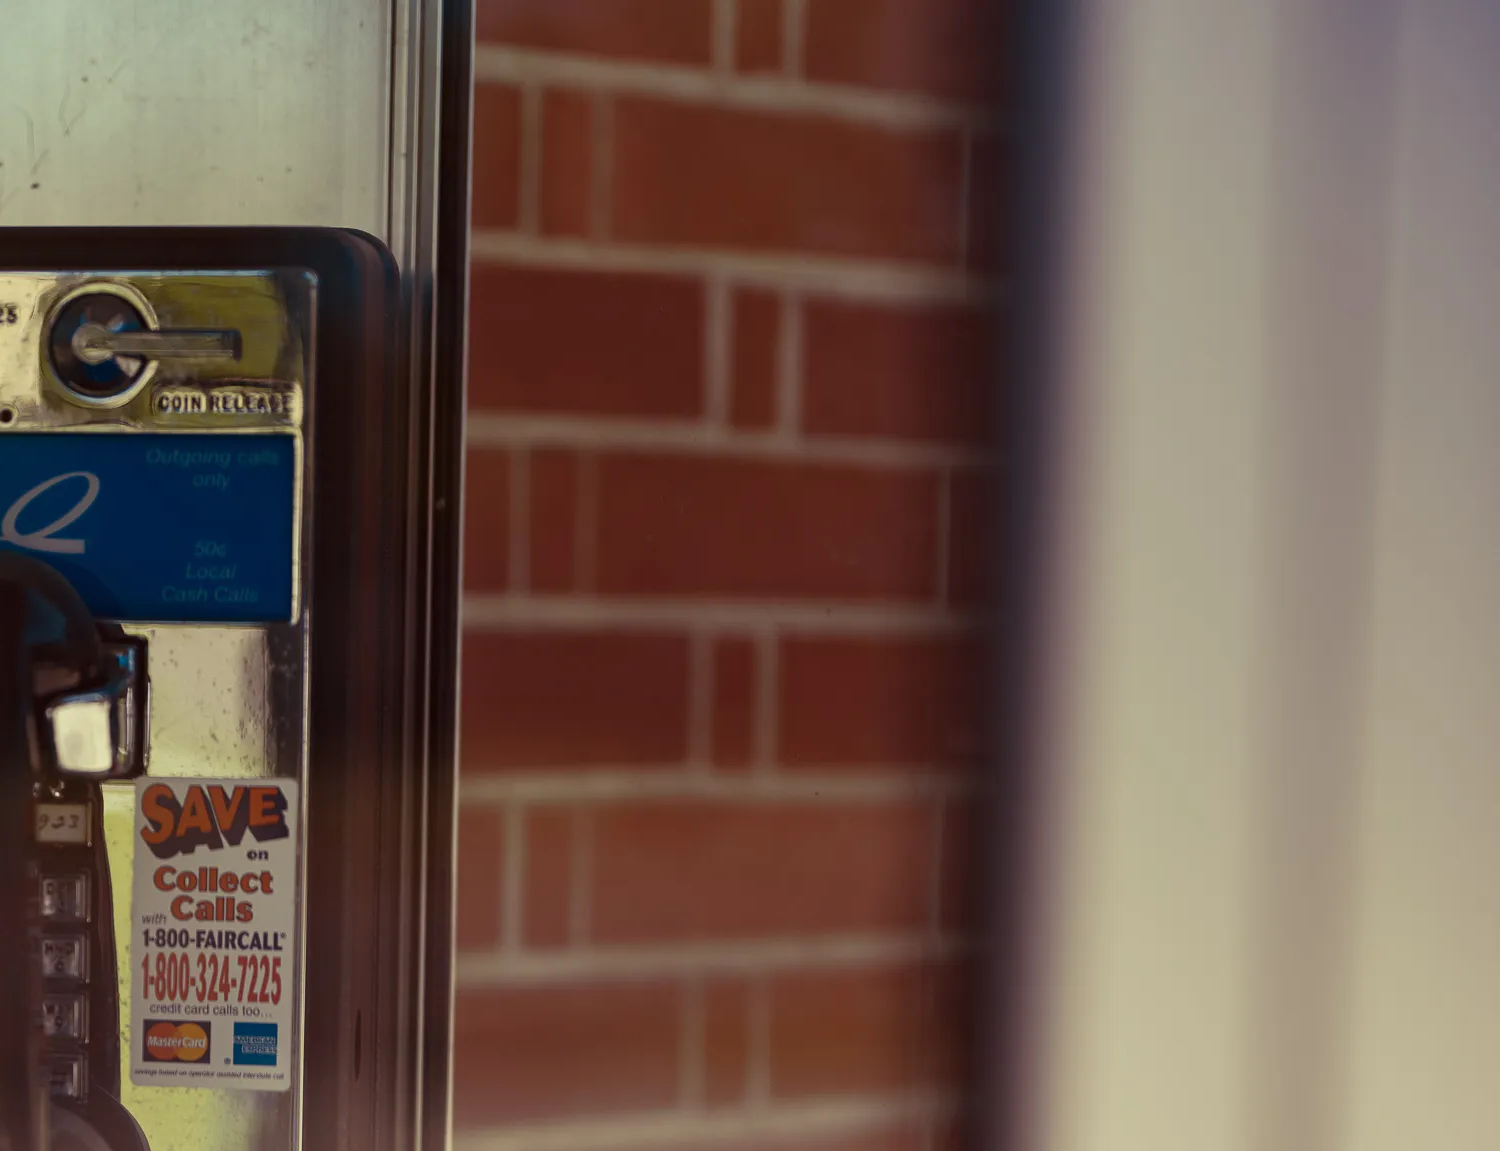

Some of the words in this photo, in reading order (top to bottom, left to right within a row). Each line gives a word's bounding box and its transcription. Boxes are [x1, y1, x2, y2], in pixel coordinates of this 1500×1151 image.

[158, 395, 202, 413] COIN
[211, 395, 294, 414] RELEASE
[146, 448, 230, 468] Outgoing
[237, 449, 279, 466] calls
[193, 472, 230, 491] only
[185, 562, 236, 579] Local
[161, 584, 207, 602] Cash
[214, 585, 259, 602] Calls
[140, 783, 289, 858] SAVE
[247, 850, 269, 861] on
[153, 865, 273, 894] Collect
[170, 896, 254, 921] Calls
[142, 913, 166, 925] with
[141, 953, 281, 1005] 1-800-324-7225
[150, 1003, 181, 1014] credit
[185, 1004, 209, 1016] card
[213, 1005, 238, 1016] calls
[147, 1036, 206, 1048] MasterCard
